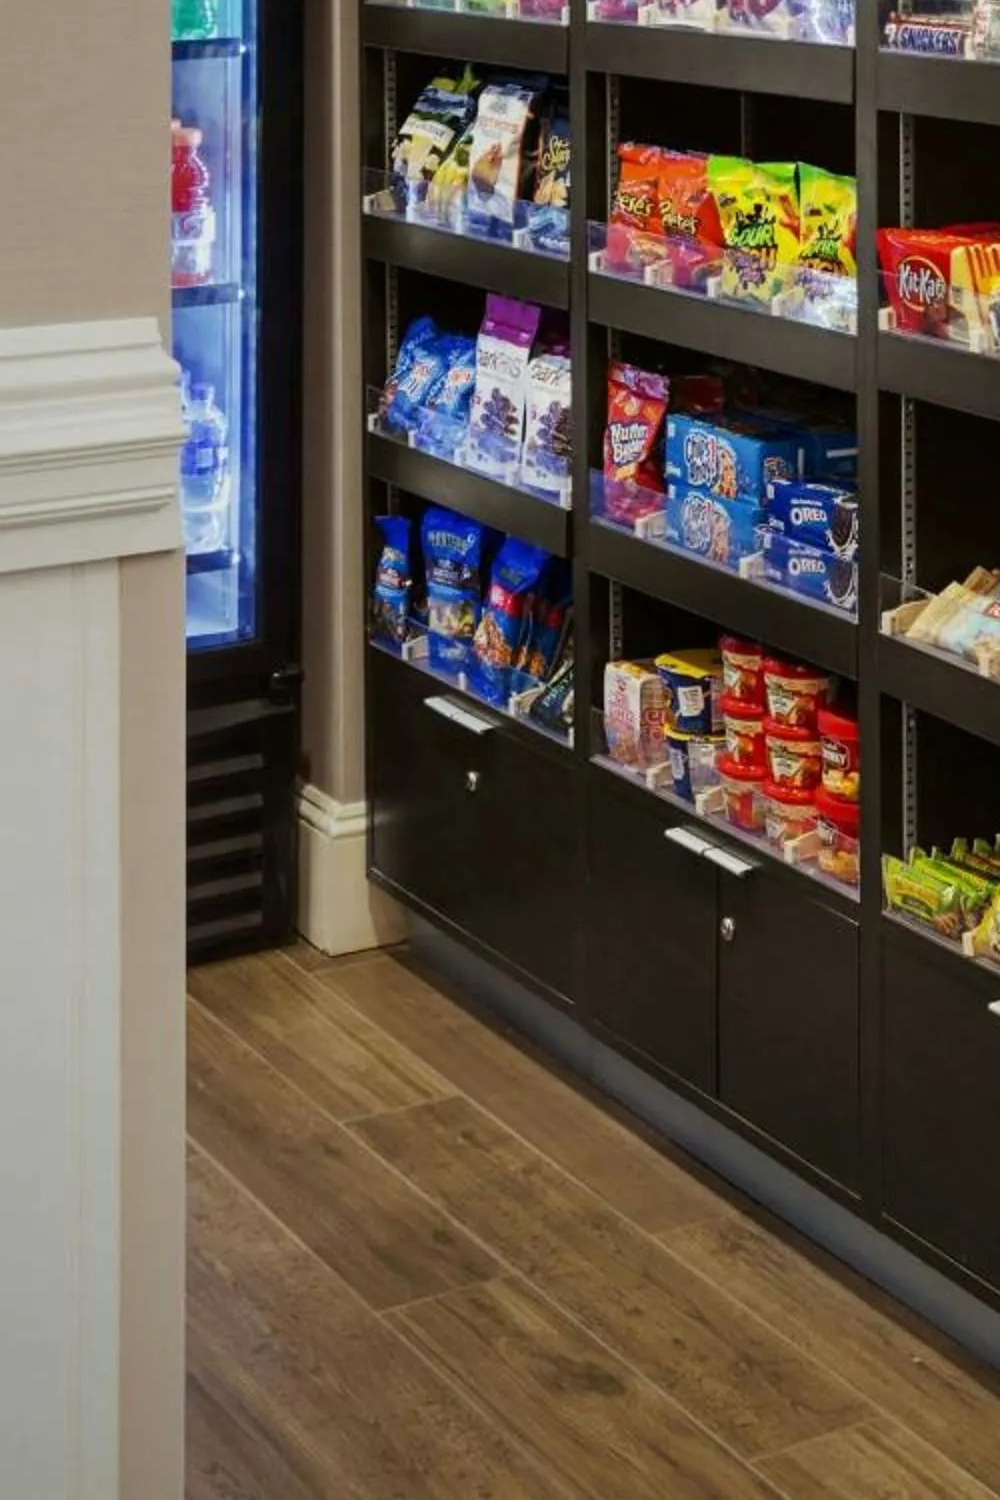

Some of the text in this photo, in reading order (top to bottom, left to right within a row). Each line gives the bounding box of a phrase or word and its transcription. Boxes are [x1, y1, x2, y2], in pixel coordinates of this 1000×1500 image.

[899, 263, 946, 302] KitKat
[790, 507, 827, 526] OREO
[788, 557, 826, 578] OREO
